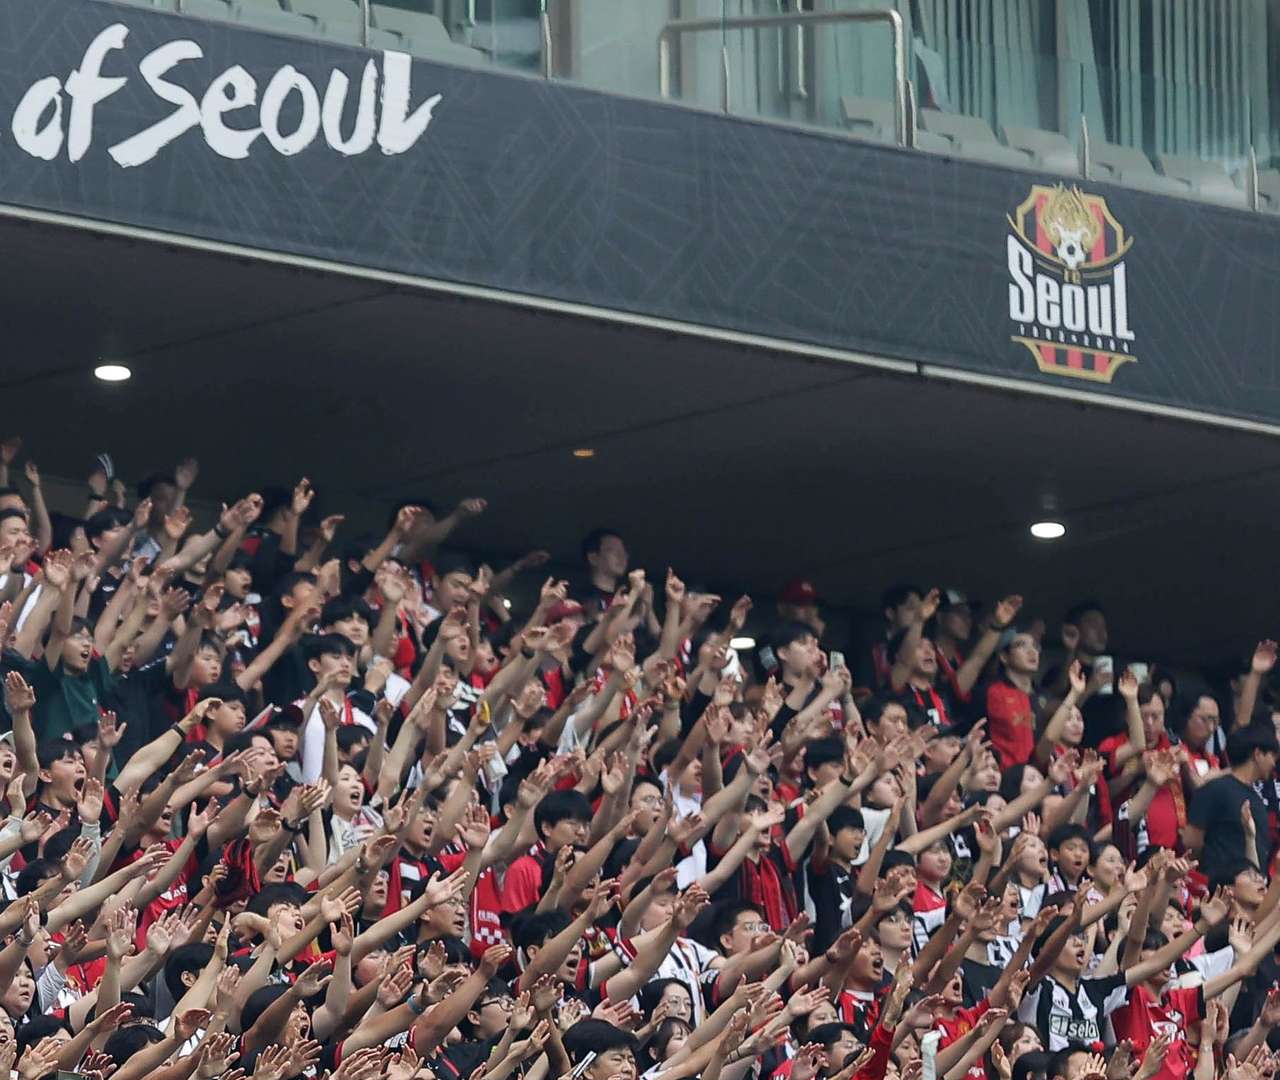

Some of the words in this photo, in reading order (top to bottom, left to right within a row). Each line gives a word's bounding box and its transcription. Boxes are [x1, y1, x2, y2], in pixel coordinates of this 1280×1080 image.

[12, 23, 128, 163] of
[108, 40, 440, 168] Seoul
[1007, 234, 1135, 341] Seoul
